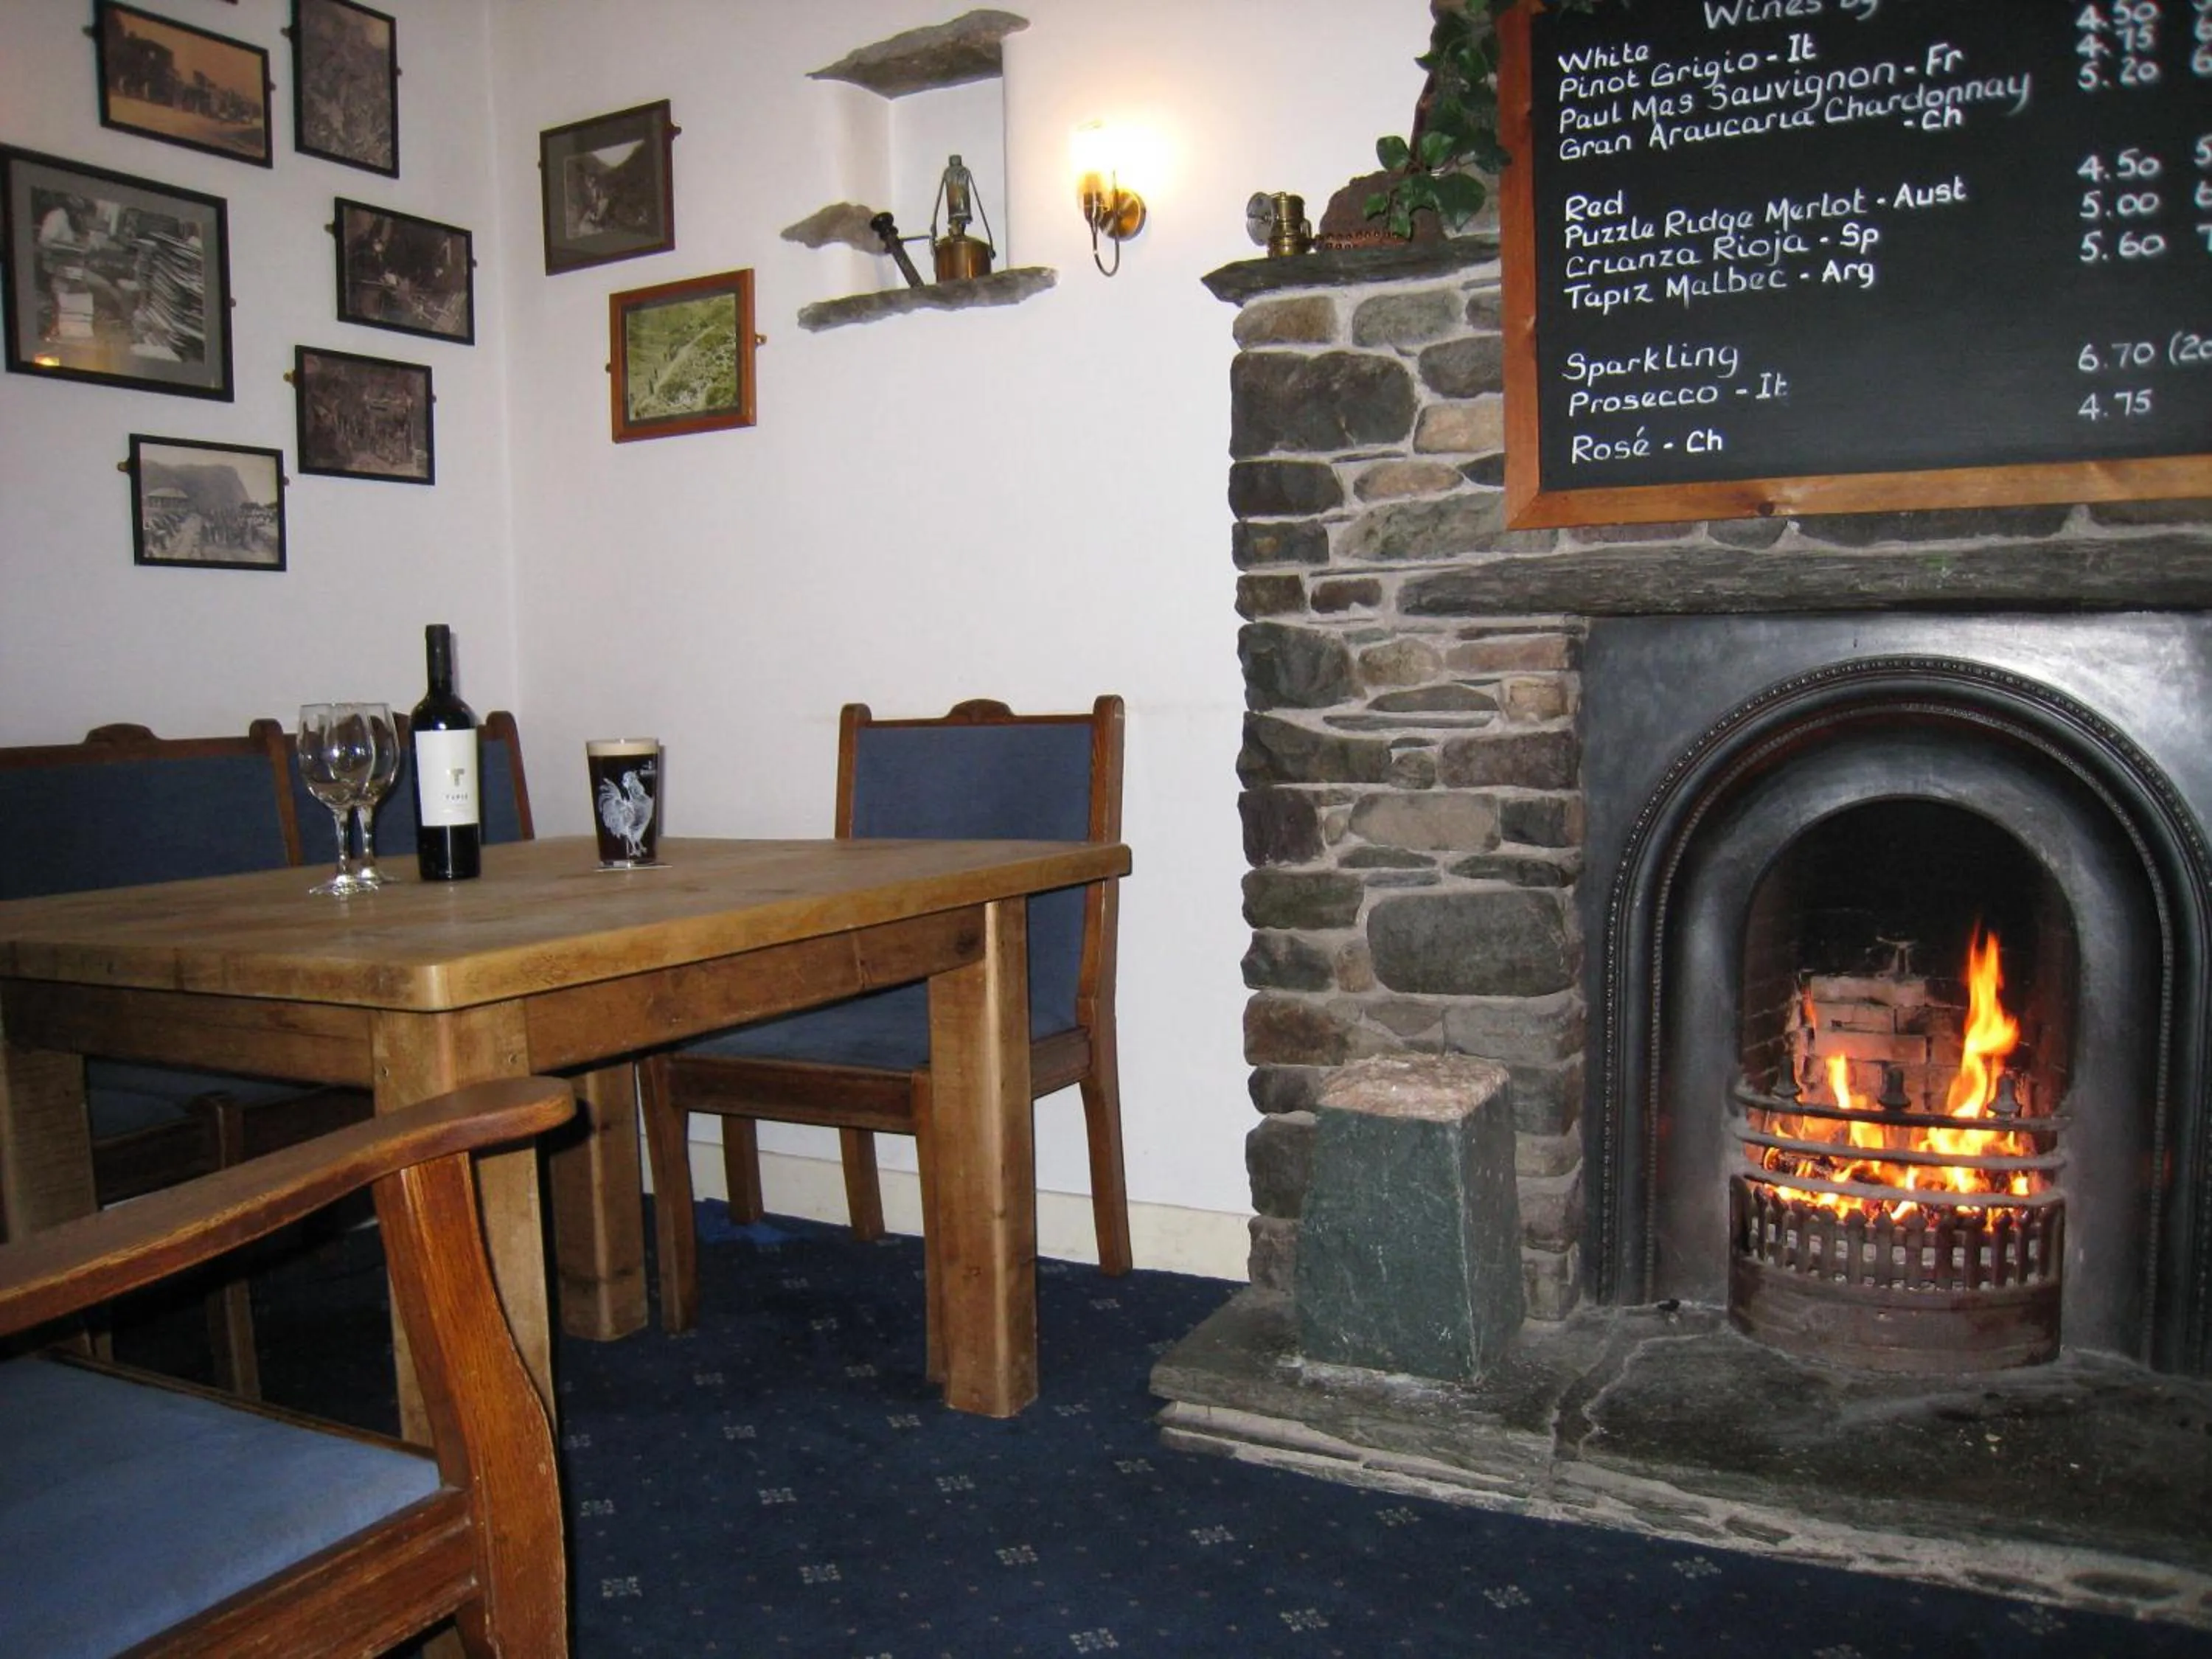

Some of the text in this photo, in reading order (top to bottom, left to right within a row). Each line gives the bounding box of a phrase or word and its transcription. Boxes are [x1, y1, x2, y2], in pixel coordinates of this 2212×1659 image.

[1703, 0, 1823, 29] Wines
[1557, 42, 1650, 74] White
[1558, 69, 1641, 102] Pinot
[1650, 50, 1759, 88] Grigio
[1787, 32, 1818, 63] It
[2077, 56, 2160, 91] 5.20
[1558, 101, 1623, 135] Paul
[1631, 93, 1694, 125] Mas
[1708, 61, 1896, 112] Sauvignon
[1924, 42, 1964, 77] Fr
[1559, 72, 2031, 161] Gran Araucaria Chardonnay
[1921, 105, 1964, 132] Ch
[2076, 147, 2161, 183] 4.50
[1564, 189, 1624, 223] Red
[1564, 215, 1656, 250] Puzzle
[1663, 208, 1753, 239] Ridge
[1764, 188, 1868, 233] Merlot
[1892, 175, 1967, 209] Aust
[2079, 189, 2160, 220] 5.00
[1565, 247, 1702, 279] Crianza
[1712, 234, 1810, 267] Rioja
[1839, 221, 1881, 255] Sp
[2079, 229, 2167, 263] 5.60
[1562, 282, 1655, 316] Tapiz
[1665, 265, 1788, 308] Malbec
[1820, 259, 1875, 290] Arg
[1561, 343, 1739, 388] Sparkling
[2077, 342, 2156, 372] 6.70
[1568, 385, 1719, 418] Prosecco
[1754, 371, 1790, 400] It
[2077, 388, 2153, 422] 4.75
[1571, 425, 1651, 465] Rosé
[1686, 428, 1724, 454] Ch
